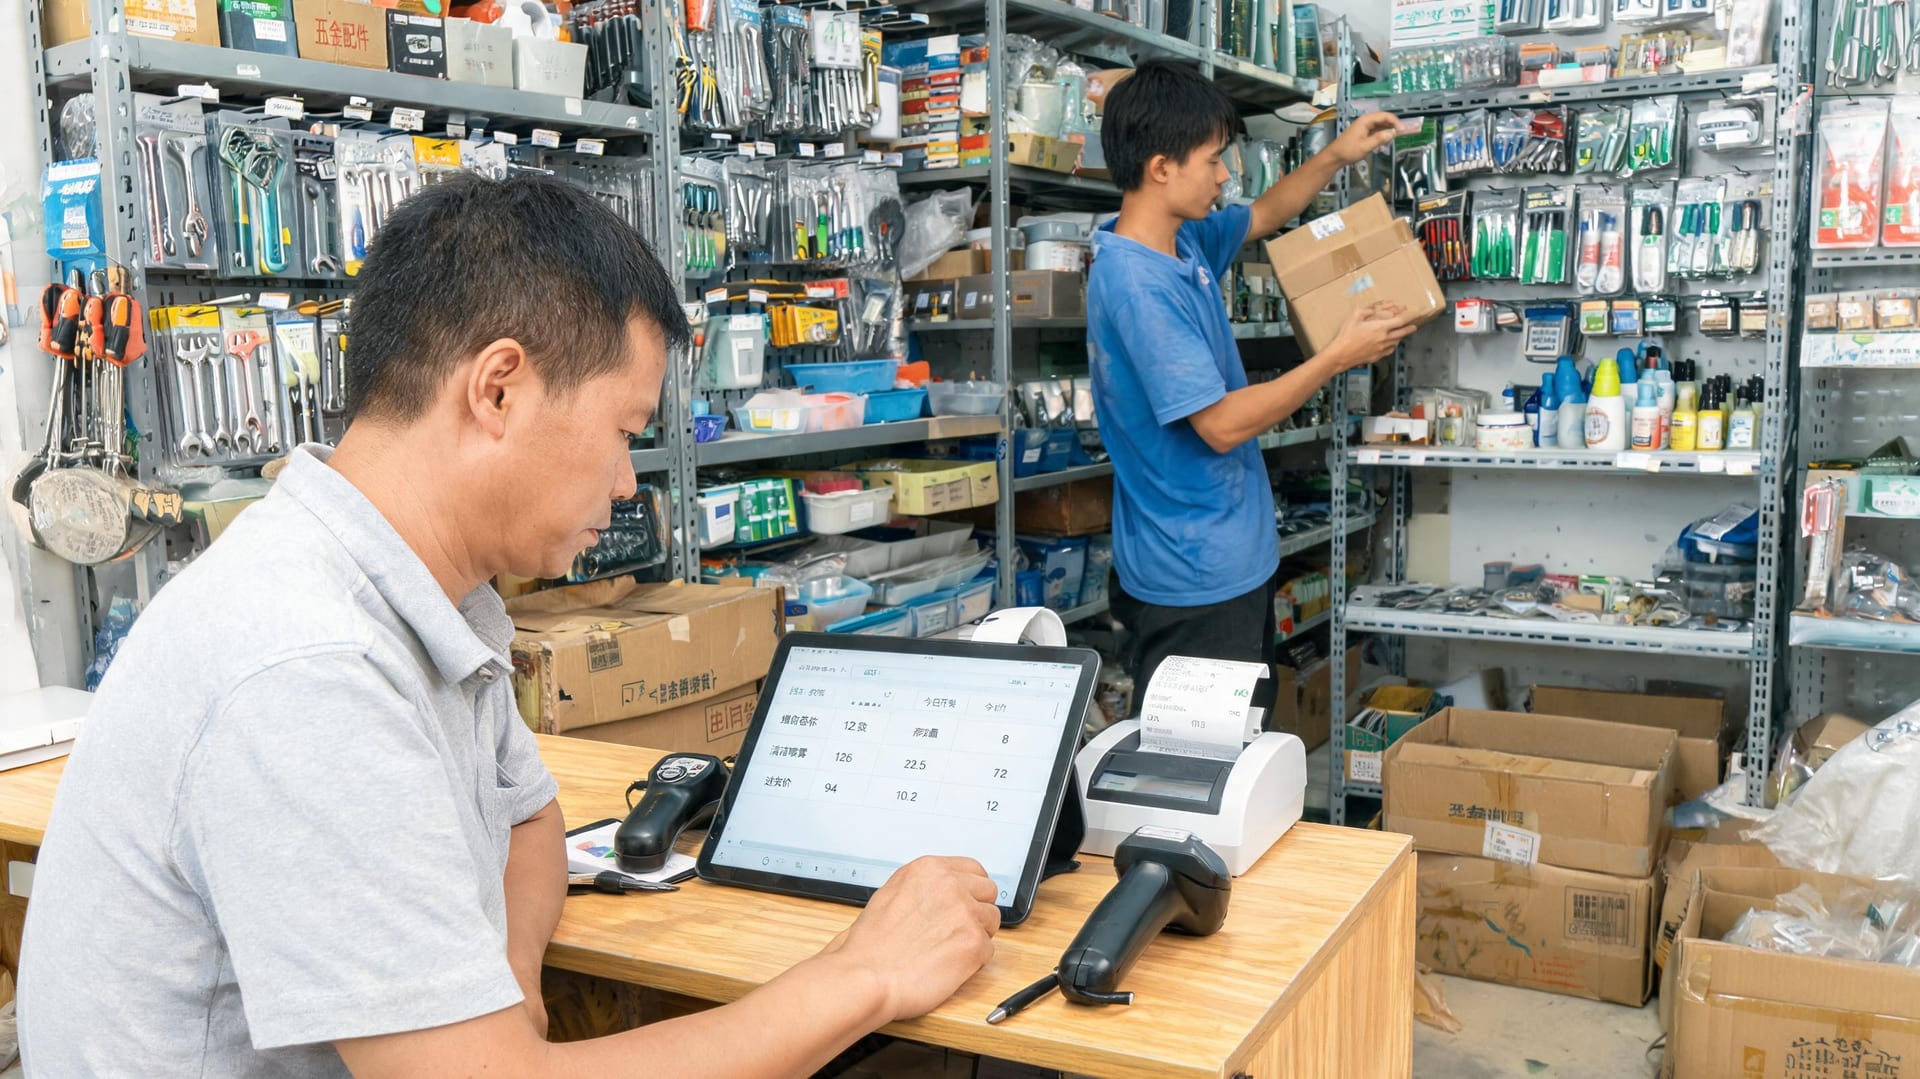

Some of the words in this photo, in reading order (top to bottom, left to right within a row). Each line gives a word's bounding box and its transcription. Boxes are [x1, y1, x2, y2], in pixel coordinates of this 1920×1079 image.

[315, 18, 369, 52] 五金配件
[844, 720, 857, 732] 12
[1001, 734, 1010, 745] 8
[835, 752, 853, 763] 126
[904, 759, 927, 771] 22.5
[993, 768, 1009, 779] 72
[824, 782, 838, 794] 94
[896, 790, 918, 802] 10.2
[986, 800, 999, 812] 12
